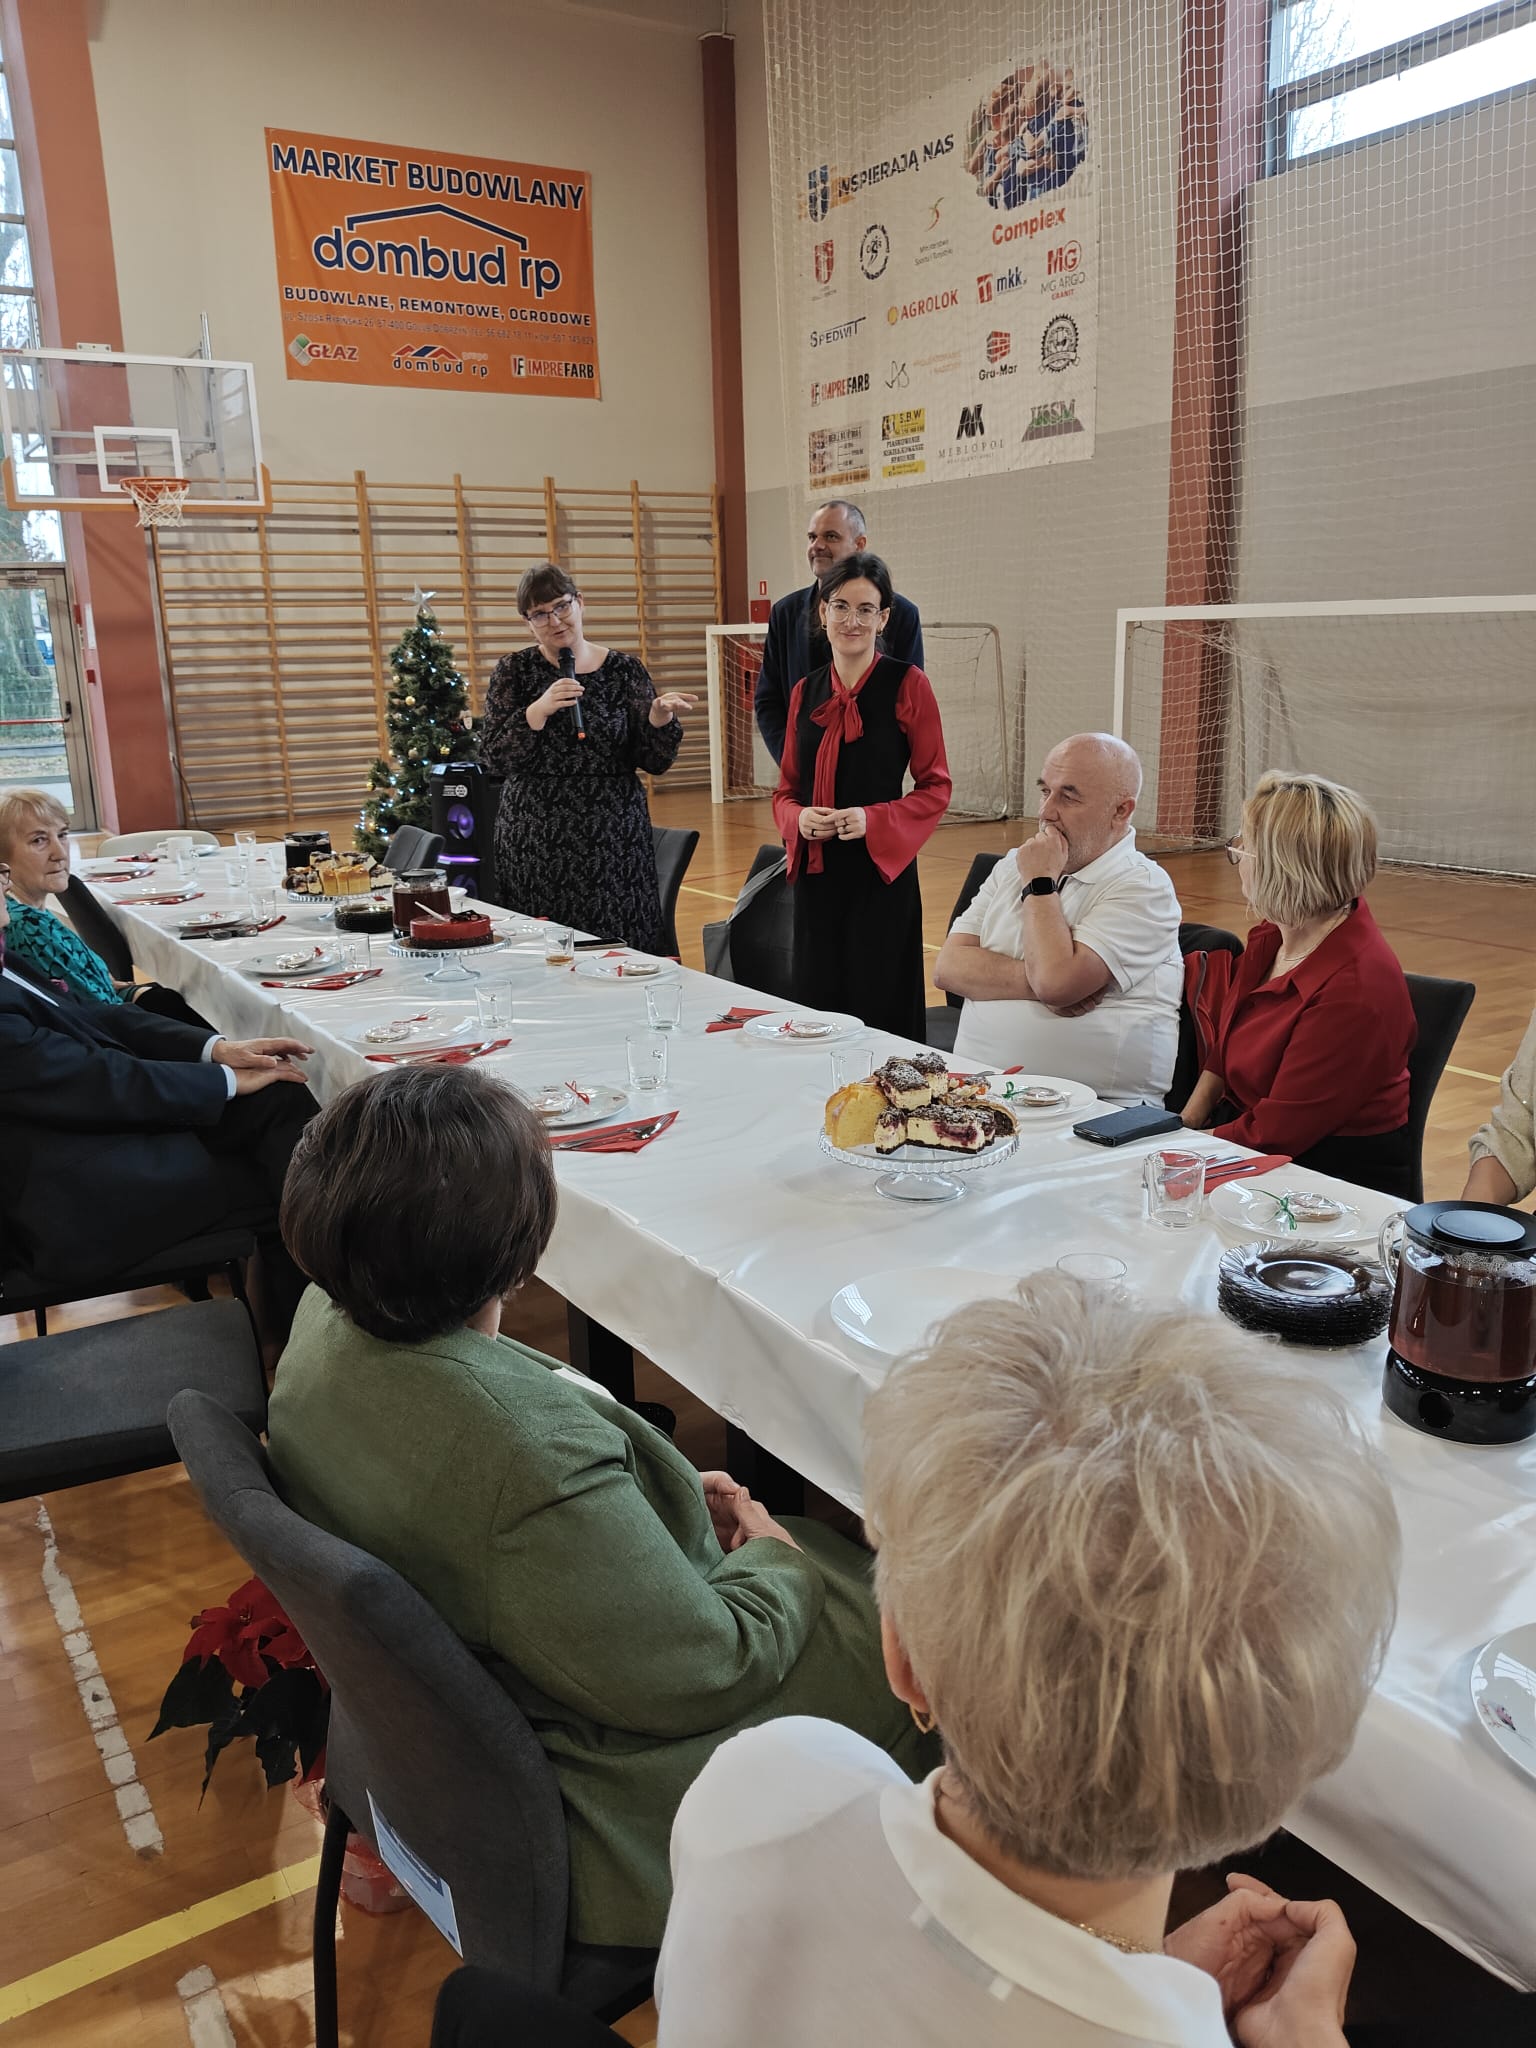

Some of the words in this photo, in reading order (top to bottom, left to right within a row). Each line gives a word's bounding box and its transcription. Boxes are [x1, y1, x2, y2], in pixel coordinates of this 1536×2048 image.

[923, 133, 954, 163] NAS
[271, 144, 398, 187] MARKET
[407, 162, 584, 209] BUDOWLANY
[992, 206, 1066, 245] Complex
[314, 226, 507, 286] dombud
[520, 256, 562, 299] rp
[1058, 271, 1086, 289] ARGO
[284, 286, 395, 312] BUDOWLANE,
[399, 297, 505, 322] REMONTOWE,
[509, 308, 592, 327] OGRODOWE
[900, 288, 959, 321] AGROLOK
[307, 342, 360, 361] GŁAZ
[392, 357, 463, 373] dombud
[471, 365, 489, 378] rp
[527, 358, 595, 380] IMPREFARB
[978, 363, 1018, 381] Gru-Mar
[820, 373, 870, 401] IMPREFARB
